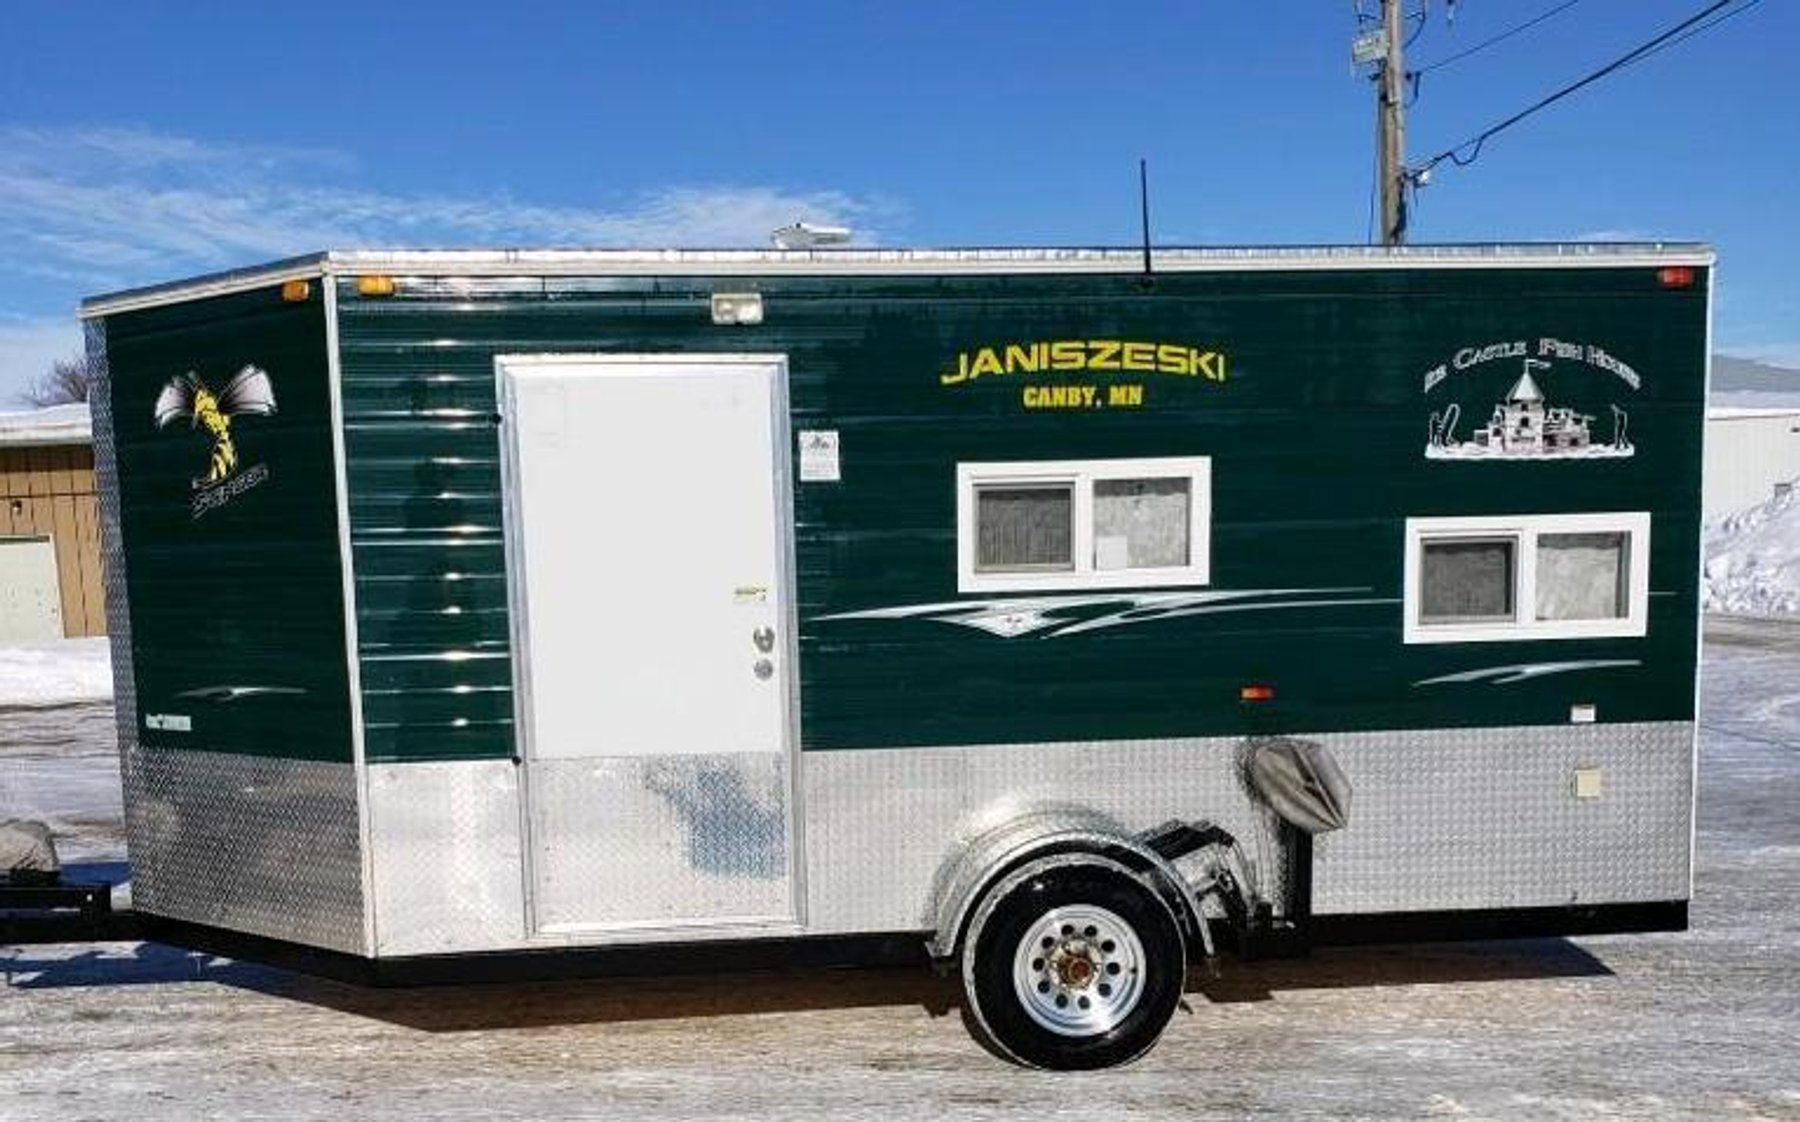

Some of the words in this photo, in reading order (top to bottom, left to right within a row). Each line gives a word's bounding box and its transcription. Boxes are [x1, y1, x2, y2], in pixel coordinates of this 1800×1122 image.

[940, 340, 1225, 384] JANISZESKI
[1022, 386, 1102, 408] CANBY,
[1108, 385, 1143, 406] MN
